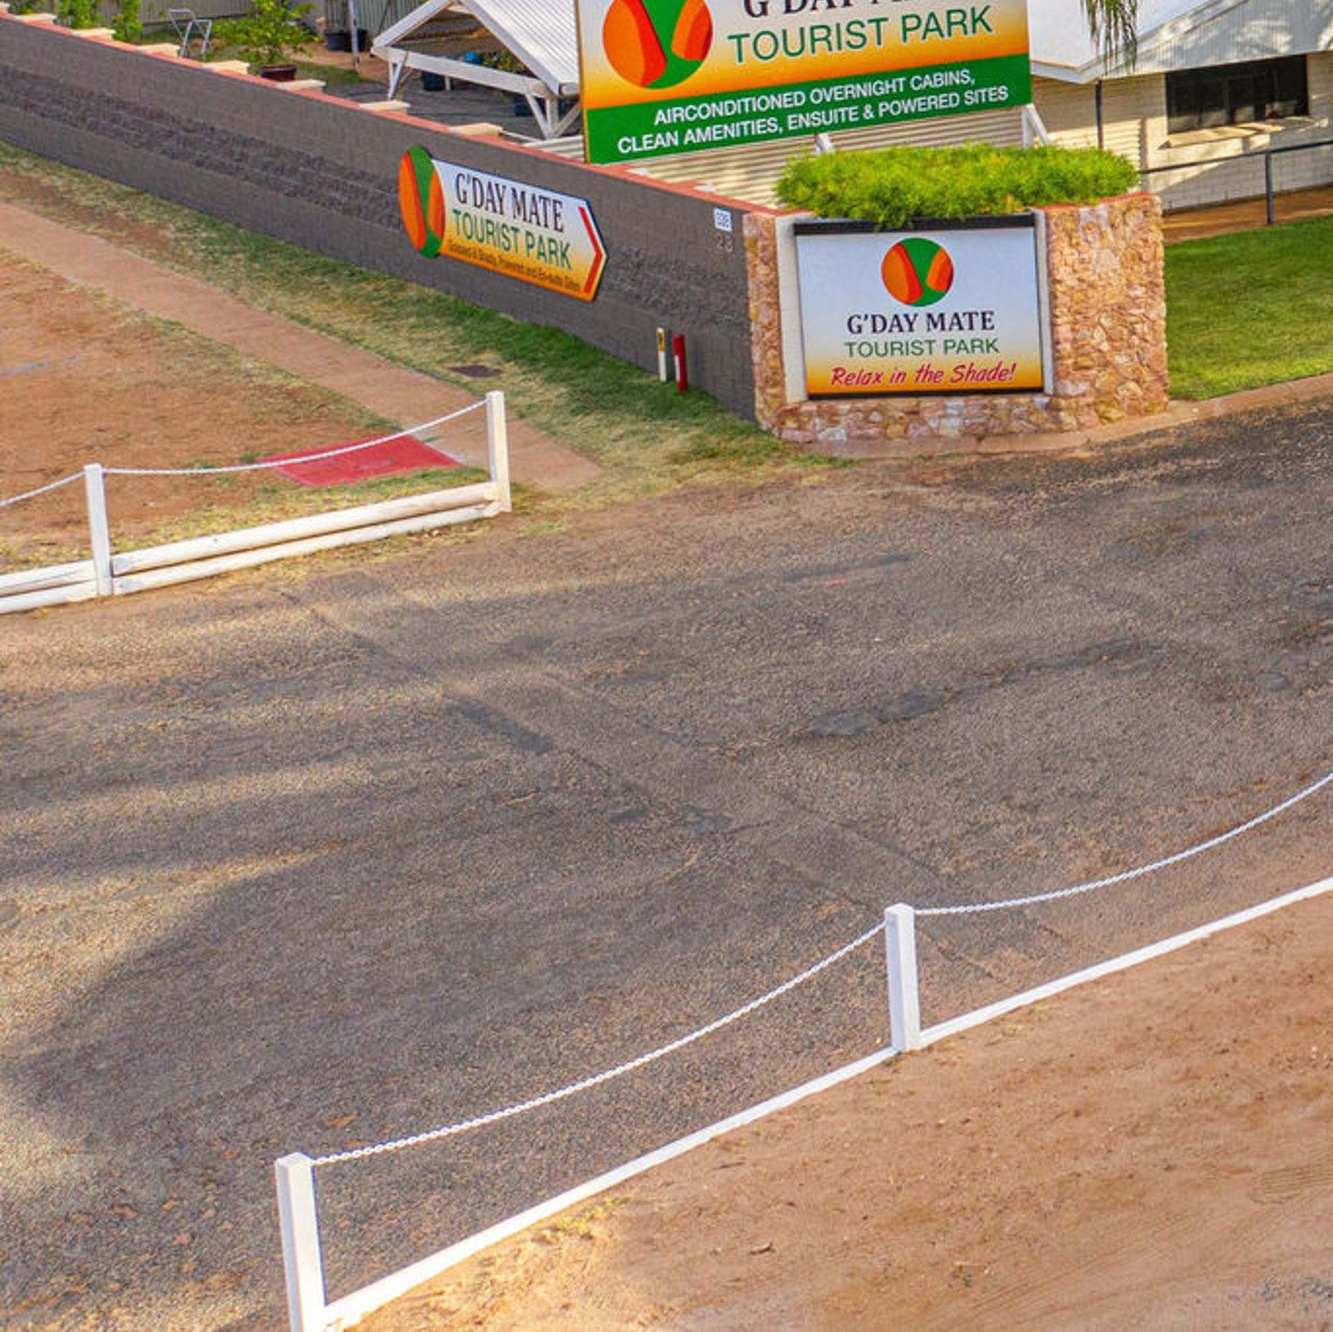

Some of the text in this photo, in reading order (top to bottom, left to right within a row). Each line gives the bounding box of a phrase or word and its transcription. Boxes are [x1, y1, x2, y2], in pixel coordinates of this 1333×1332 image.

[728, 5, 993, 63] TOURIST PARK
[617, 86, 1009, 154] CLEAN AMENITIES, ENSUITE & POWERED SITES
[654, 69, 975, 126] AIRCONDITIONED OVERNIGHT CABINS,
[456, 173, 565, 232] G'DAY MATE
[453, 209, 520, 254] TOURIST
[525, 232, 573, 270] PARK
[844, 337, 1000, 358] TOURIST PARK
[847, 310, 996, 335] G'DAY MATE
[831, 361, 1018, 386] Relax in the Shade!
